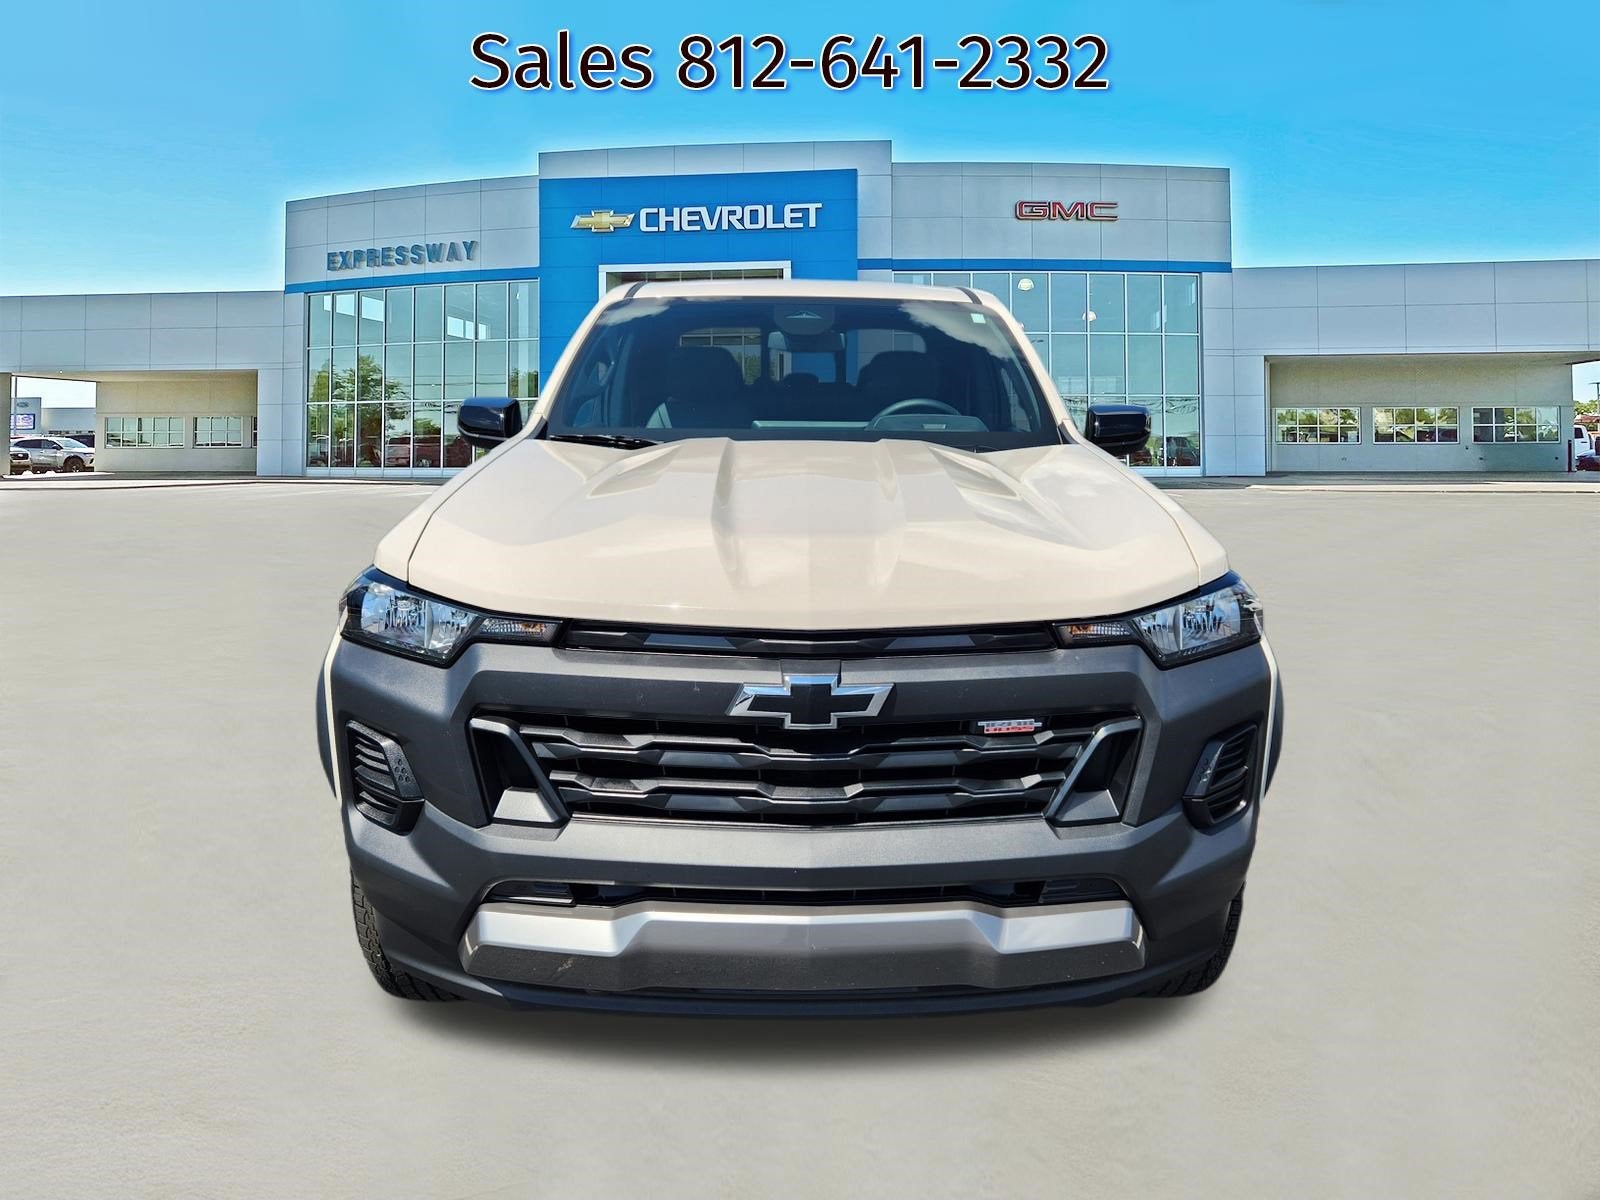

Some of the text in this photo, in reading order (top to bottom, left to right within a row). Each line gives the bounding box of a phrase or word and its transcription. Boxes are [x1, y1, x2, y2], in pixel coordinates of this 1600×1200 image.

[639, 202, 822, 232] CHEVROLET
[1015, 200, 1119, 221] GMC
[327, 240, 479, 271] EXPRESSWAY
